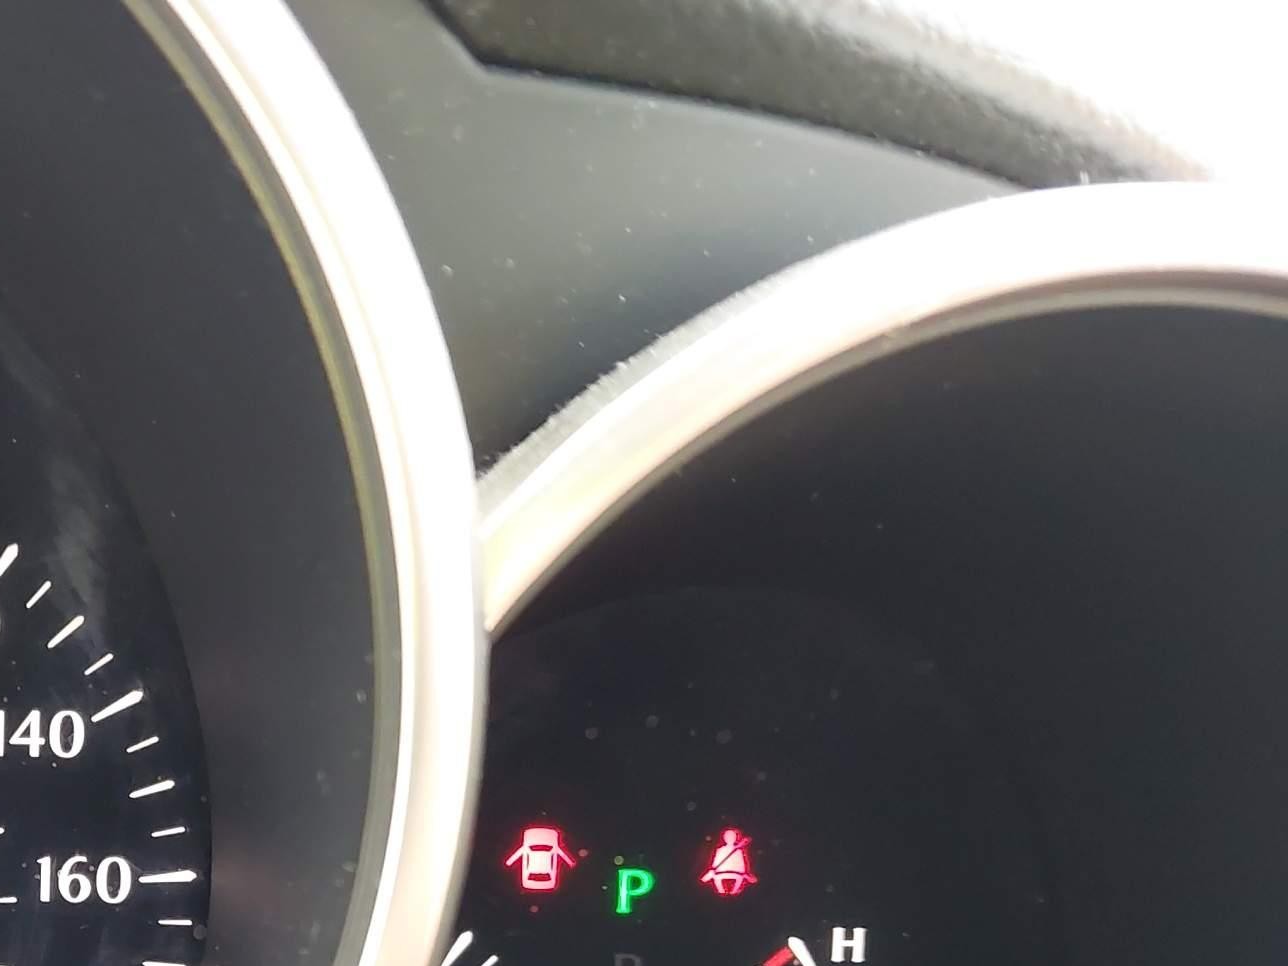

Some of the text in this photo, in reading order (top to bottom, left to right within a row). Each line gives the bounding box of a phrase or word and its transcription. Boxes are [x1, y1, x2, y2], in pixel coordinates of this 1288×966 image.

[36, 856, 132, 904] 160
[615, 868, 654, 914] P
[830, 926, 866, 963] H
